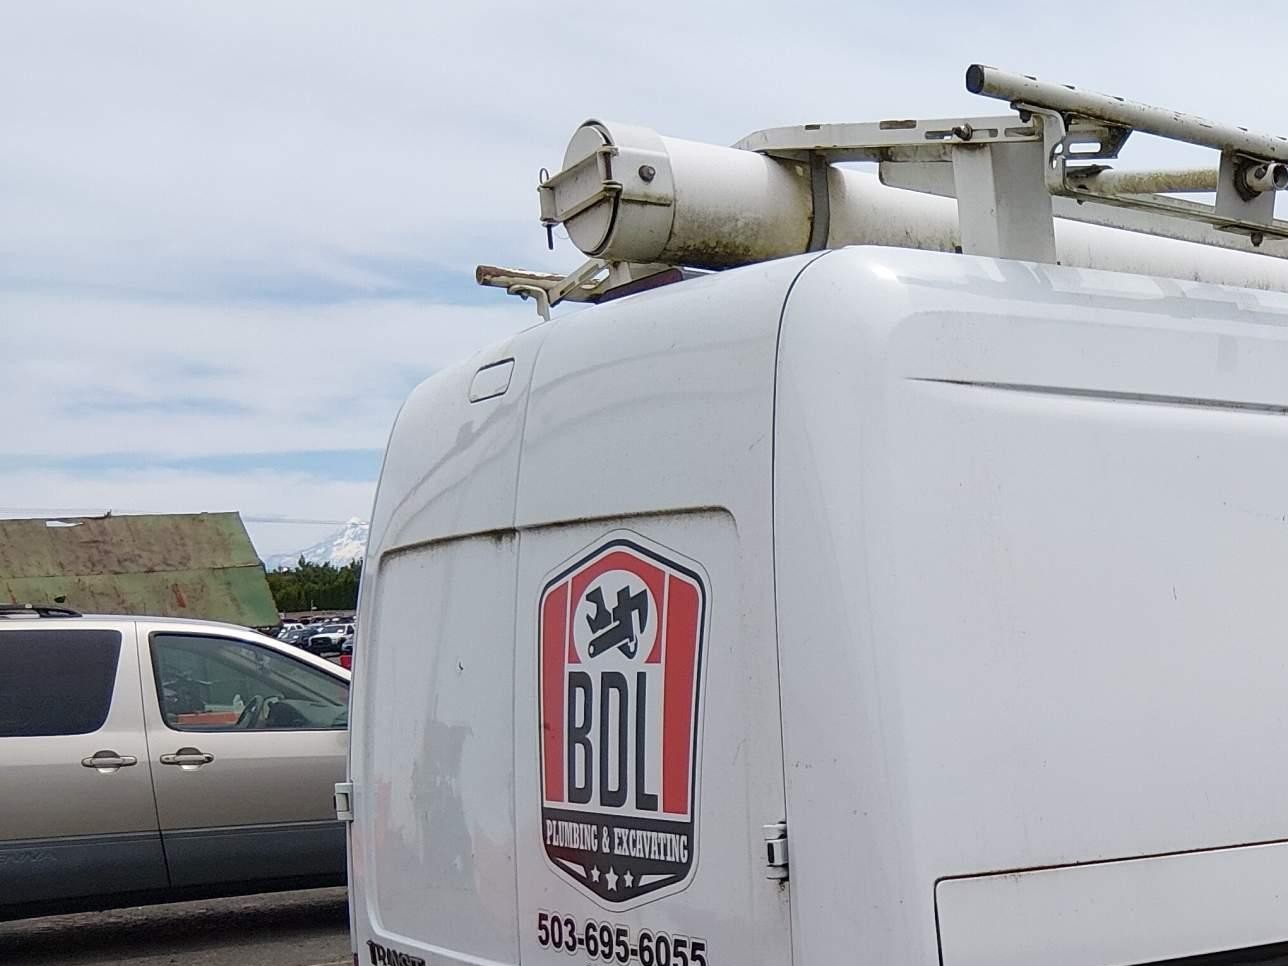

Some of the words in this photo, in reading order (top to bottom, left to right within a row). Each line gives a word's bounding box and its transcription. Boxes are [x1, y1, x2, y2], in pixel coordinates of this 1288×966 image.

[568, 671, 658, 811] BDL
[546, 820, 598, 852] PLUMBING
[602, 826, 610, 853] &
[613, 827, 689, 864] EXCAVATING
